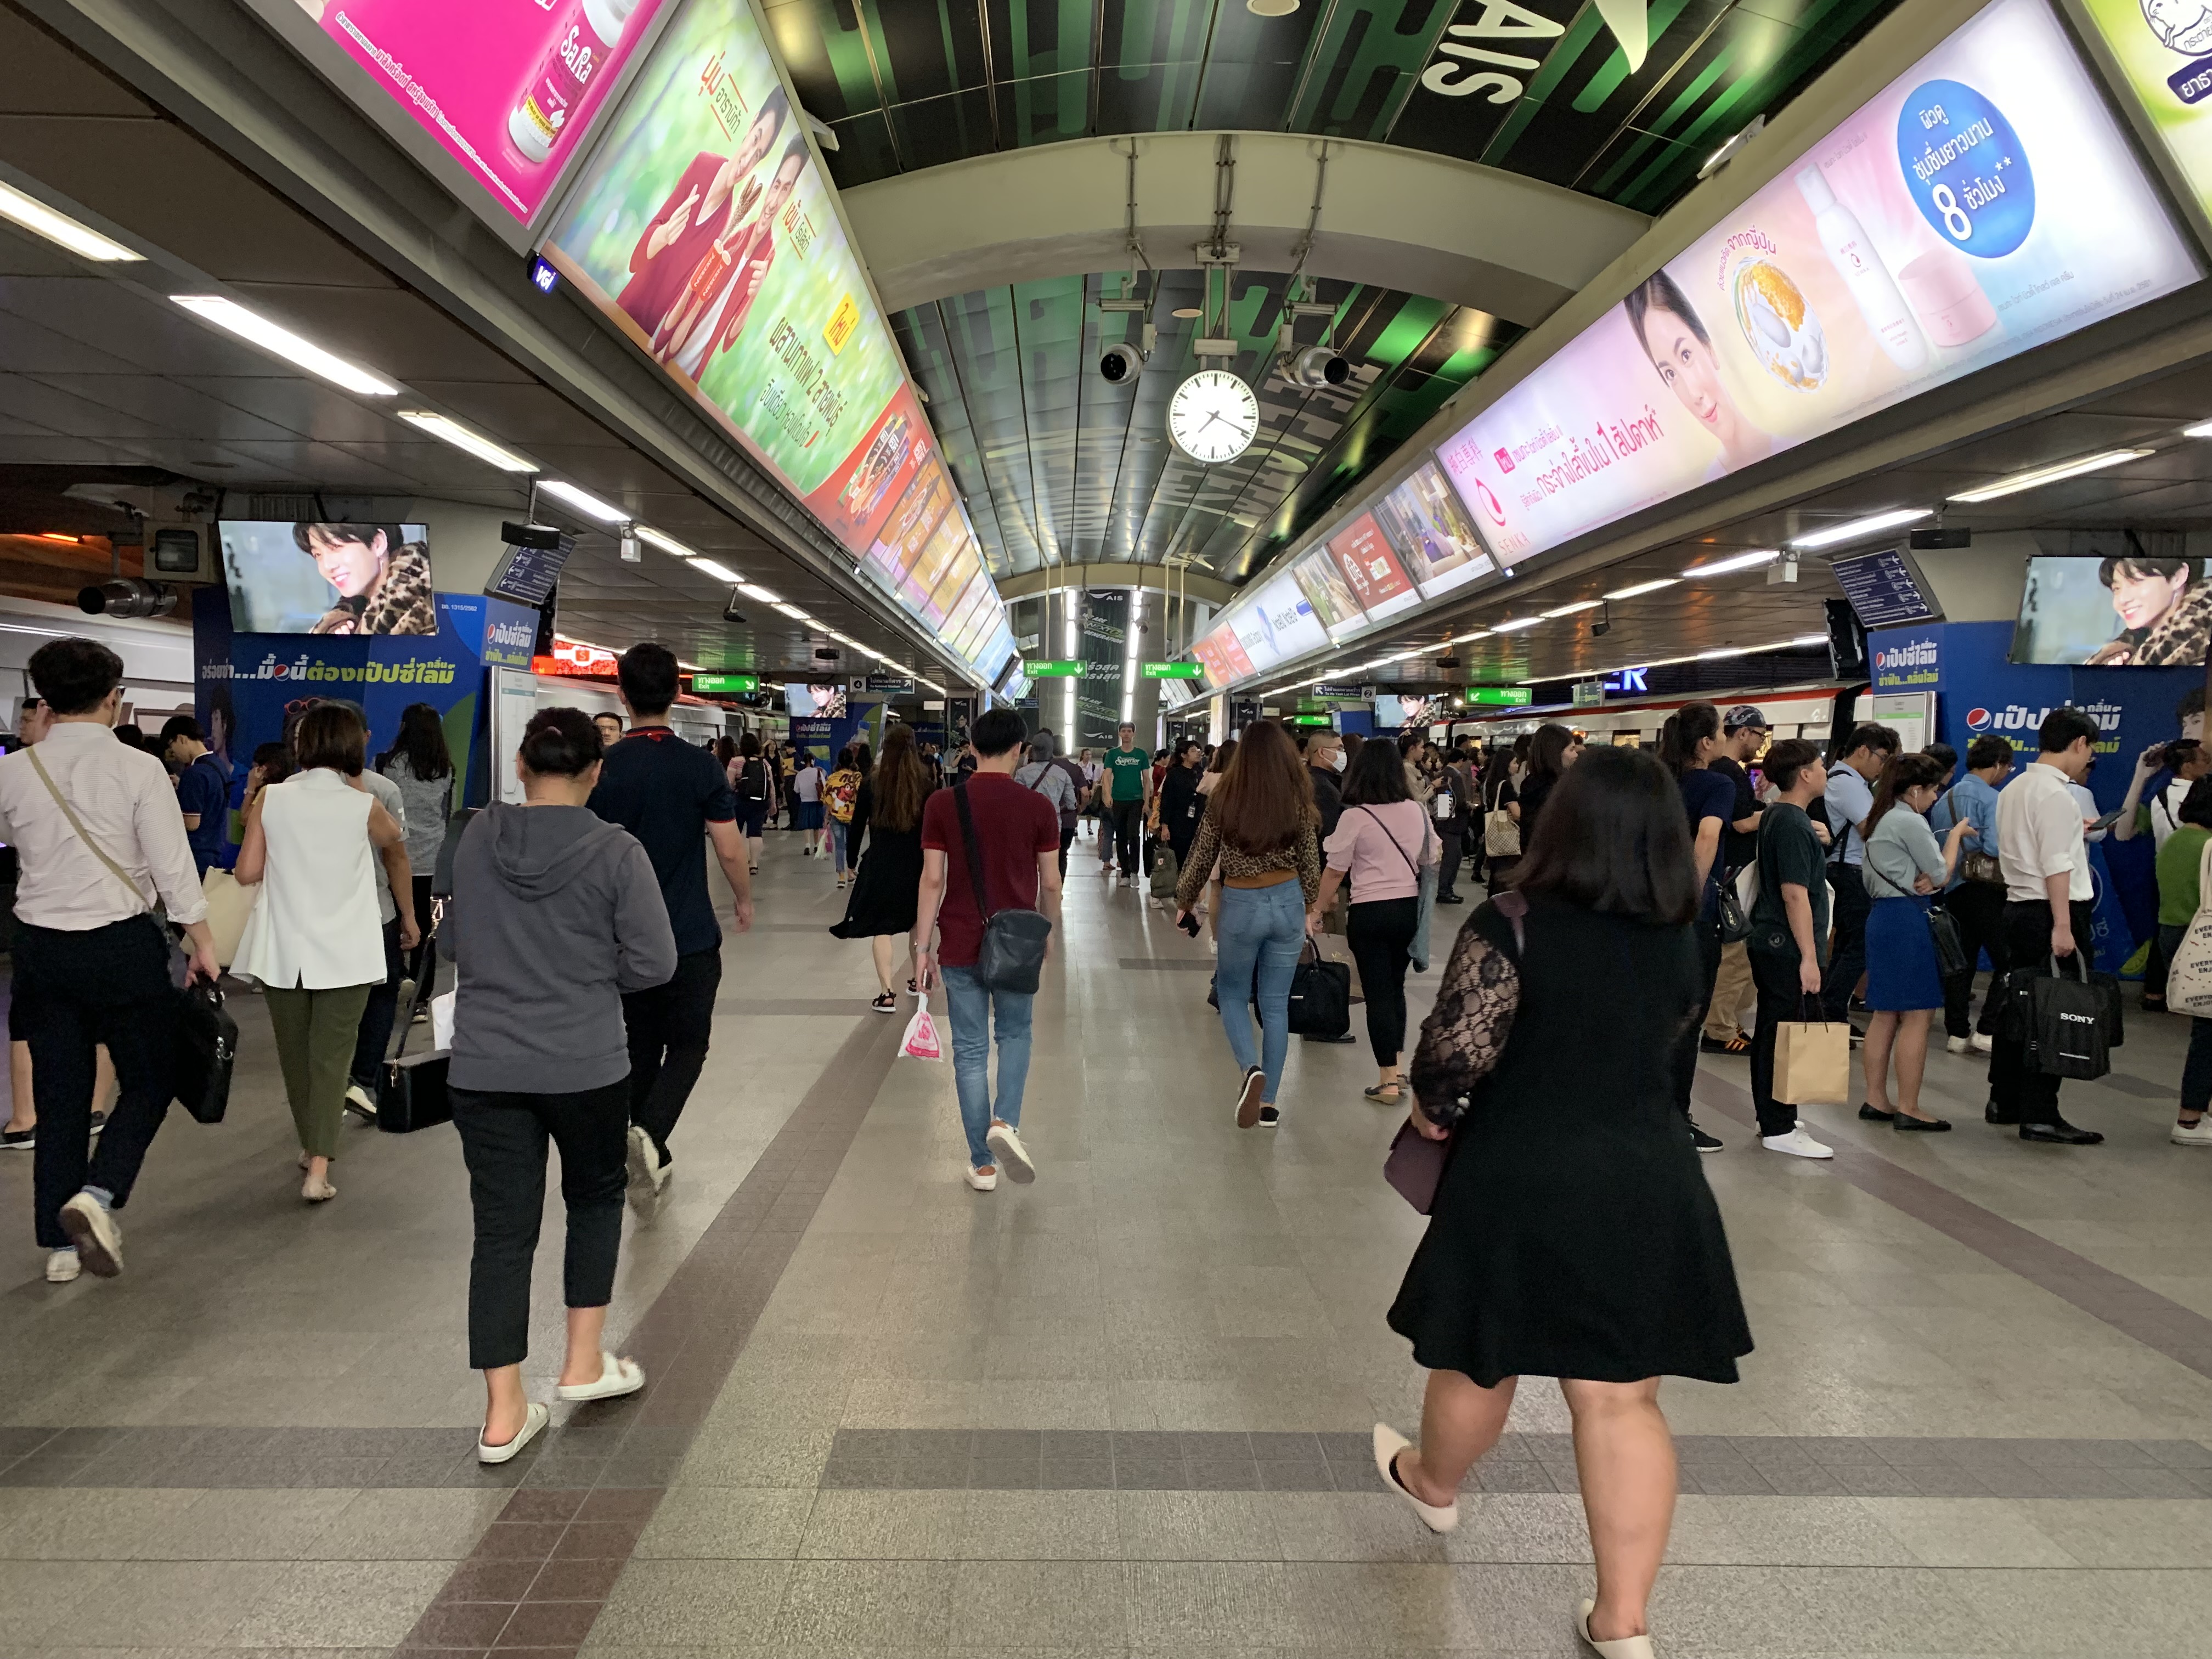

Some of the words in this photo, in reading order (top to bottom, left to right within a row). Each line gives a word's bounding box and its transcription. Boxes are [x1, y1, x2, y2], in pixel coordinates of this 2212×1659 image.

[561, 25, 592, 84] SaRa
[1421, 0, 1565, 104] AIS
[698, 50, 726, 97] นุ่ม
[716, 87, 741, 134] อาราบิก้า
[1919, 104, 1949, 129] ผิวดู
[1912, 117, 1994, 186] ชุ่มชื่นยาวนาน
[783, 200, 802, 234] เข้ม
[1932, 183, 1972, 241] 8
[1727, 224, 1776, 255] จากญี่ปุ่น
[828, 302, 856, 346] ใหม่
[769, 317, 820, 388] ผสานกาแฟ
[806, 368, 823, 396] 2
[811, 380, 848, 437] สายพันธุ์
[1596, 421, 1620, 460] 1
[1498, 531, 1531, 555] SENKA
[697, 676, 725, 685] ทางออก
[1087, 661, 1120, 673] ร็วสุด
[1500, 690, 1527, 698] ทางออก
[1115, 756, 1141, 766] Superior
[2061, 1012, 2095, 1025] SONY
